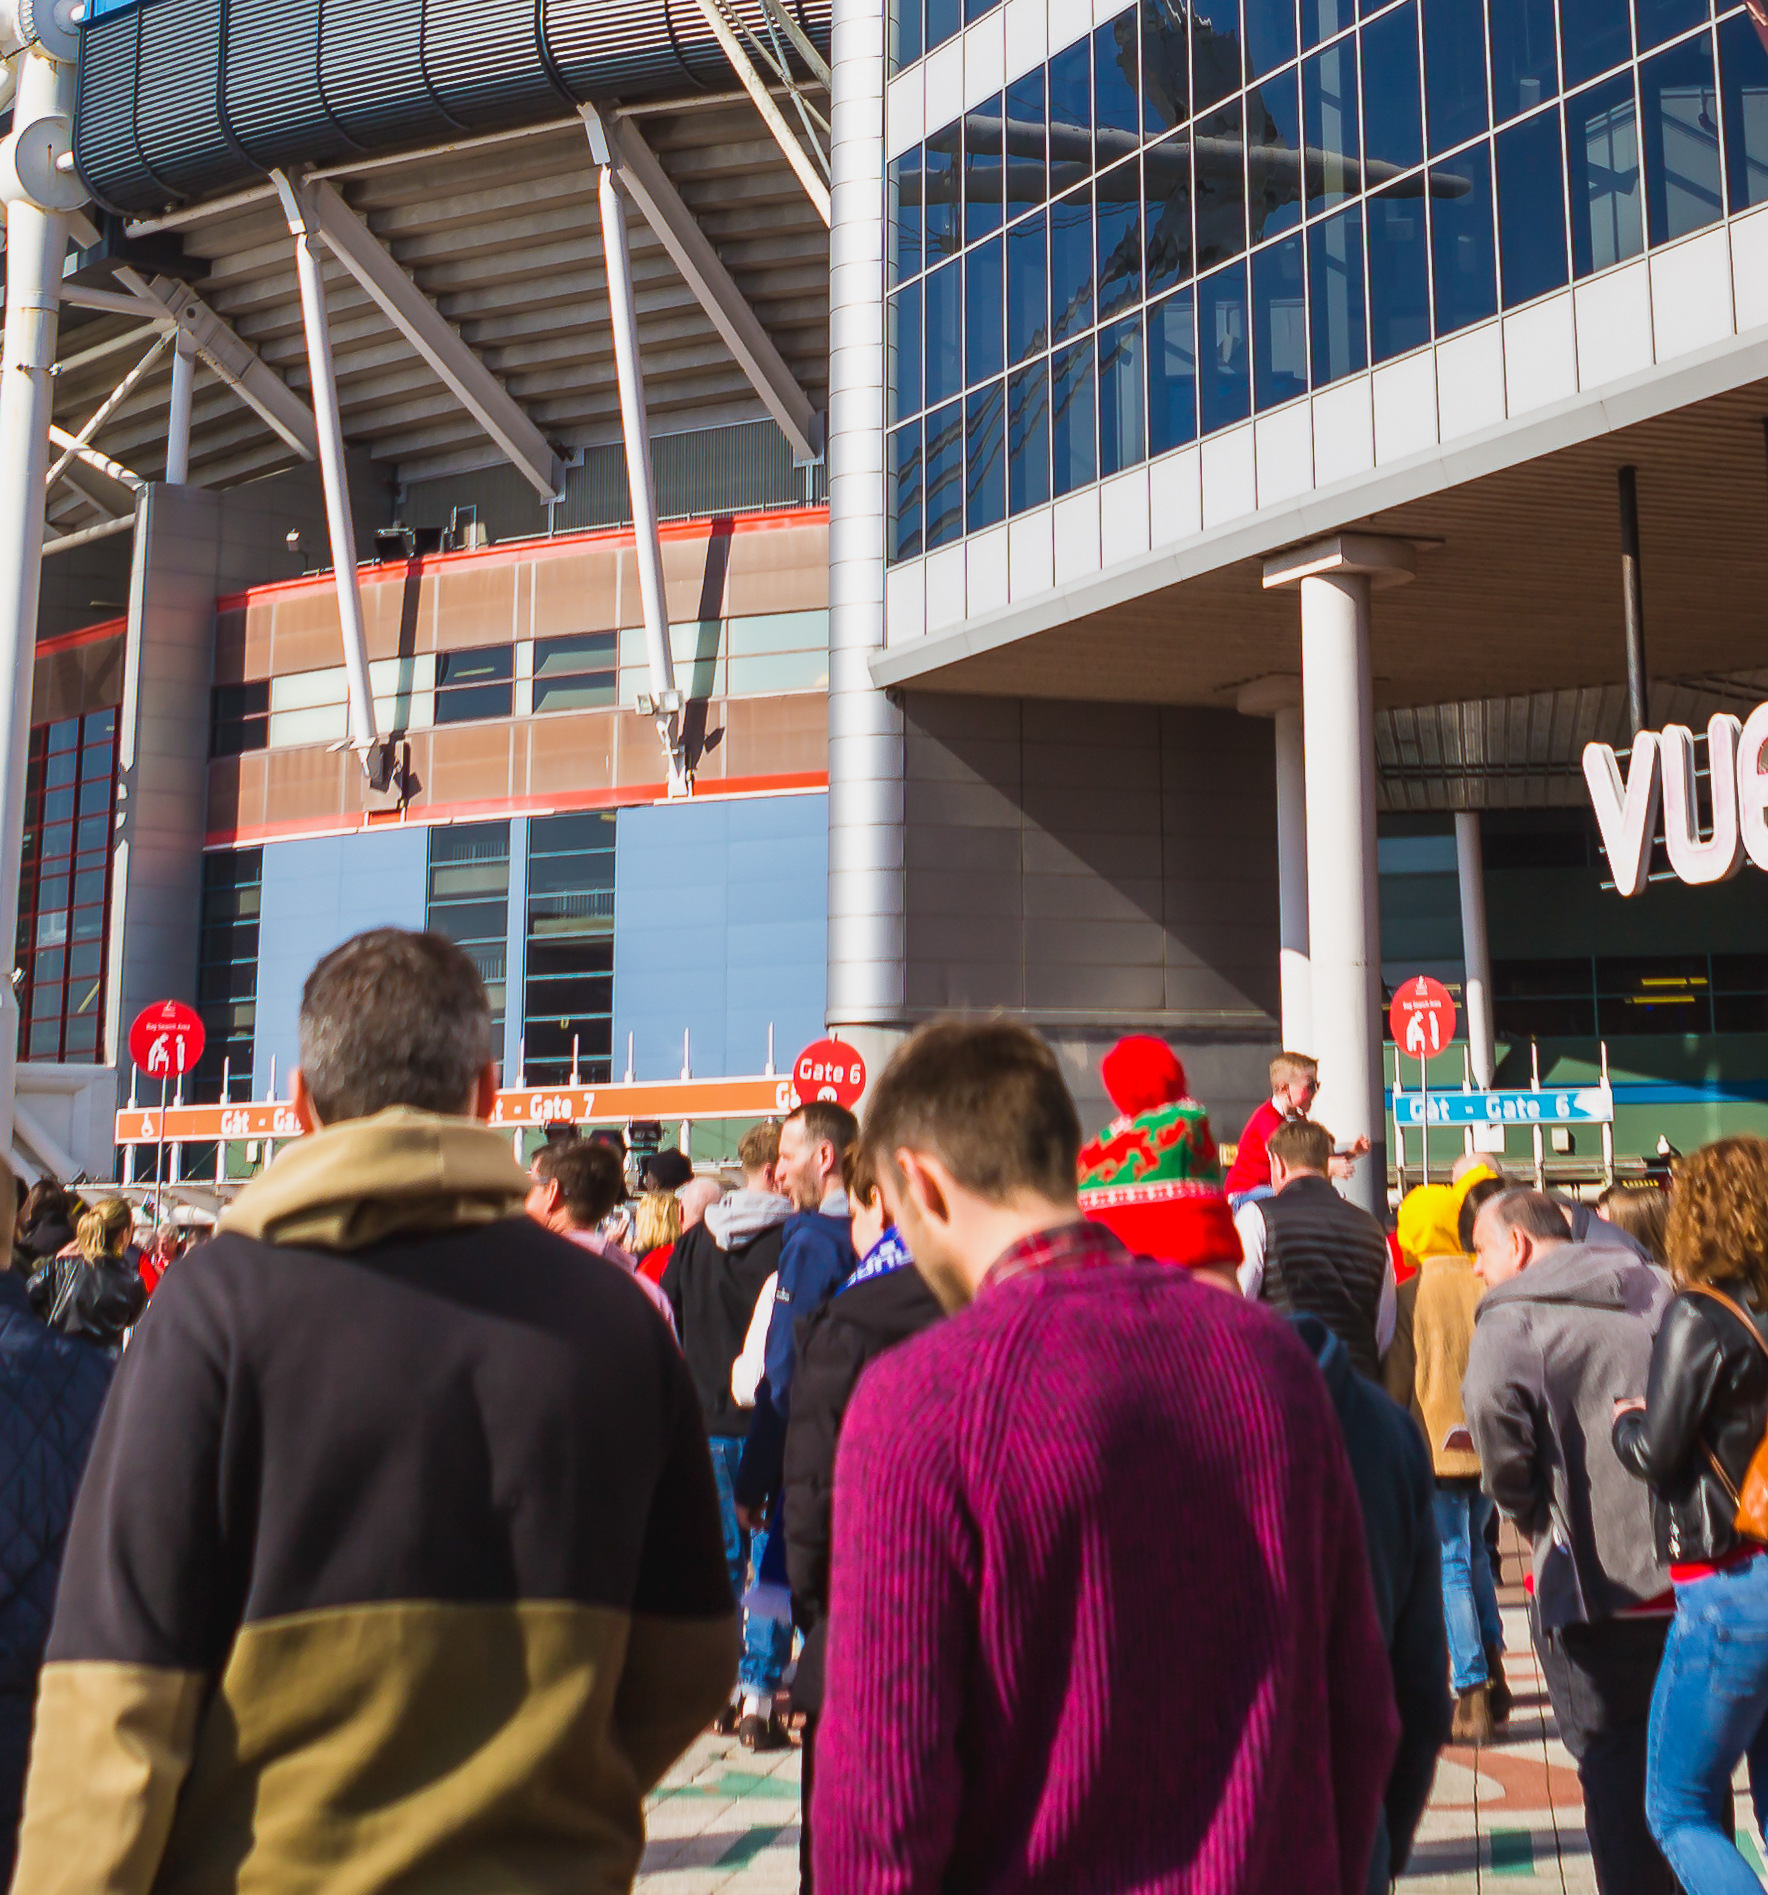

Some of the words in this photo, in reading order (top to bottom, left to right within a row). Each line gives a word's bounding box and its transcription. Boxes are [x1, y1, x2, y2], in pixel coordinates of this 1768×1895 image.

[799, 1057, 844, 1084] Gate
[849, 1063, 861, 1085] 6
[529, 1093, 573, 1120] Gate
[583, 1091, 595, 1118] 7
[1485, 1094, 1541, 1120] Gate
[1555, 1093, 1570, 1119] 6
